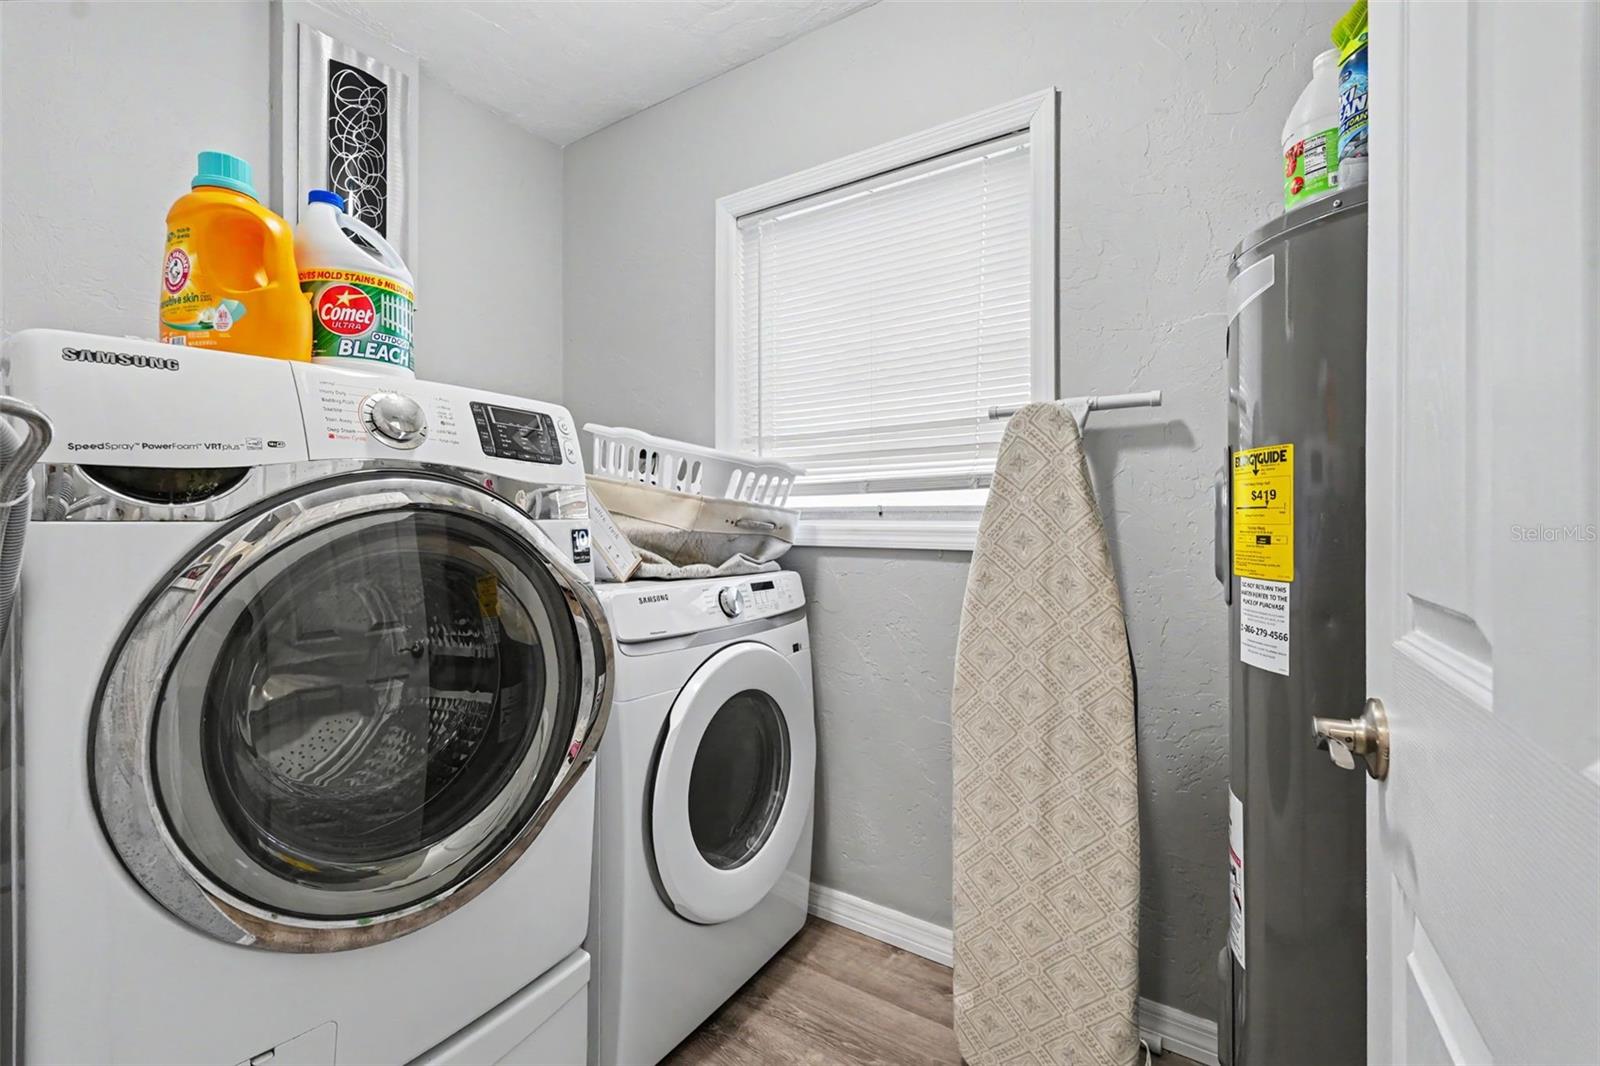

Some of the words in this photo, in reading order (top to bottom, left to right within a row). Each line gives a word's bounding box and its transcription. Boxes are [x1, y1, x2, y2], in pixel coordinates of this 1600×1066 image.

[299, 271, 316, 280] OVES
[317, 271, 343, 280] MOLD
[344, 272, 375, 285] STAINS
[183, 292, 199, 304] skin
[321, 303, 373, 324] Comet
[332, 321, 362, 330] ULTRA
[373, 333, 407, 348] OUTDO
[62, 347, 180, 372] SAMSUNG
[338, 339, 410, 367] BLEACH
[1251, 489, 1277, 501] $419
[573, 530, 588, 546] 10
[1275, 586, 1287, 594] THIS
[638, 593, 669, 604] SAMSUNG
[1278, 595, 1288, 603] THE
